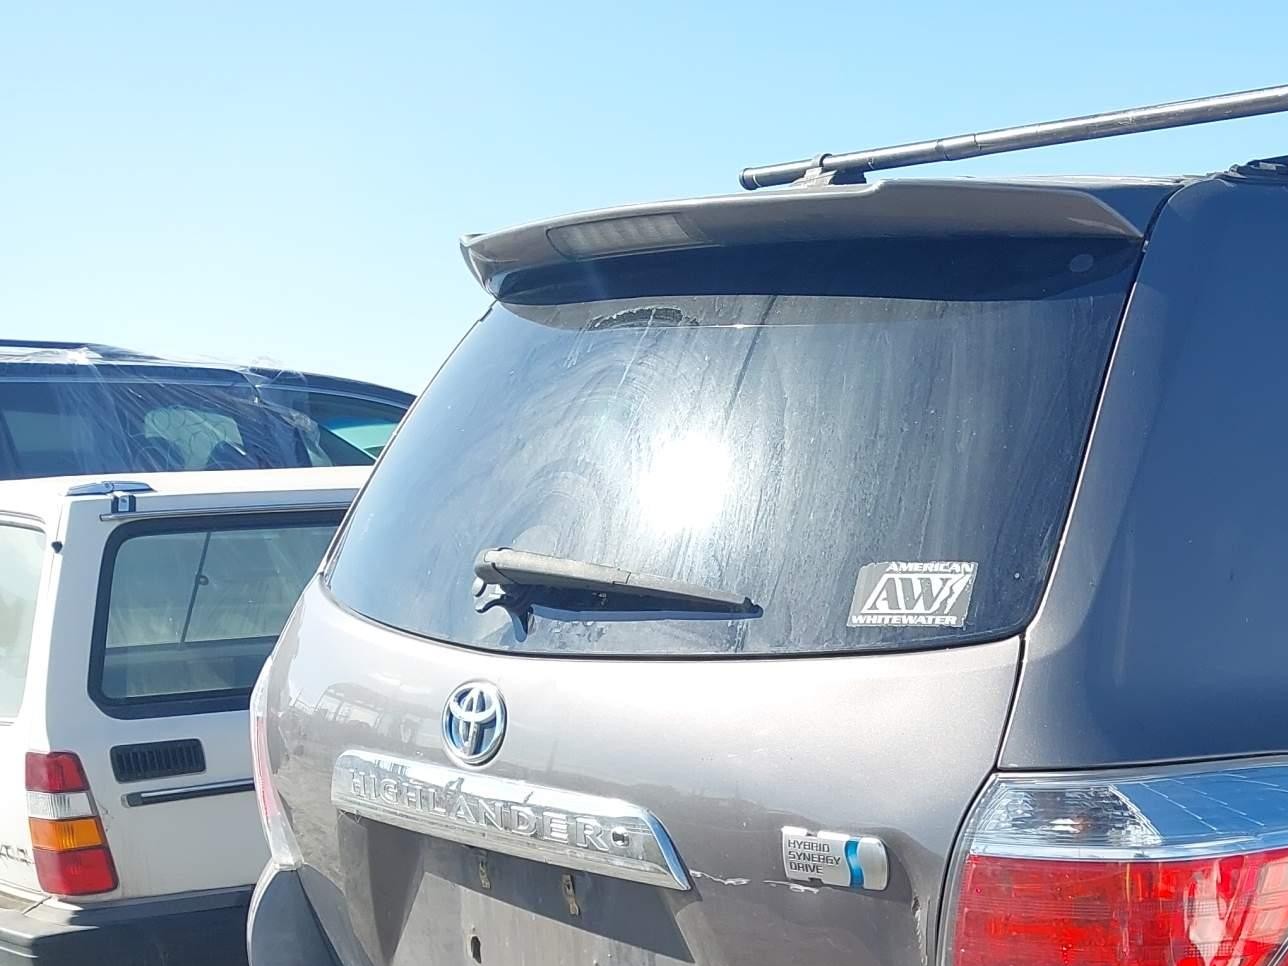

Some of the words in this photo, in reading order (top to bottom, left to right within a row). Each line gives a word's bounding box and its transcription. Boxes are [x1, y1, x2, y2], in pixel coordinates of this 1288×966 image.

[887, 561, 974, 573] AMERICAN
[851, 615, 957, 625] WHITEWATER
[350, 769, 608, 851] HIGHLANDER
[788, 839, 830, 853] HYBRID
[788, 850, 841, 865] SYNERGY
[789, 861, 824, 874] DRIVE
